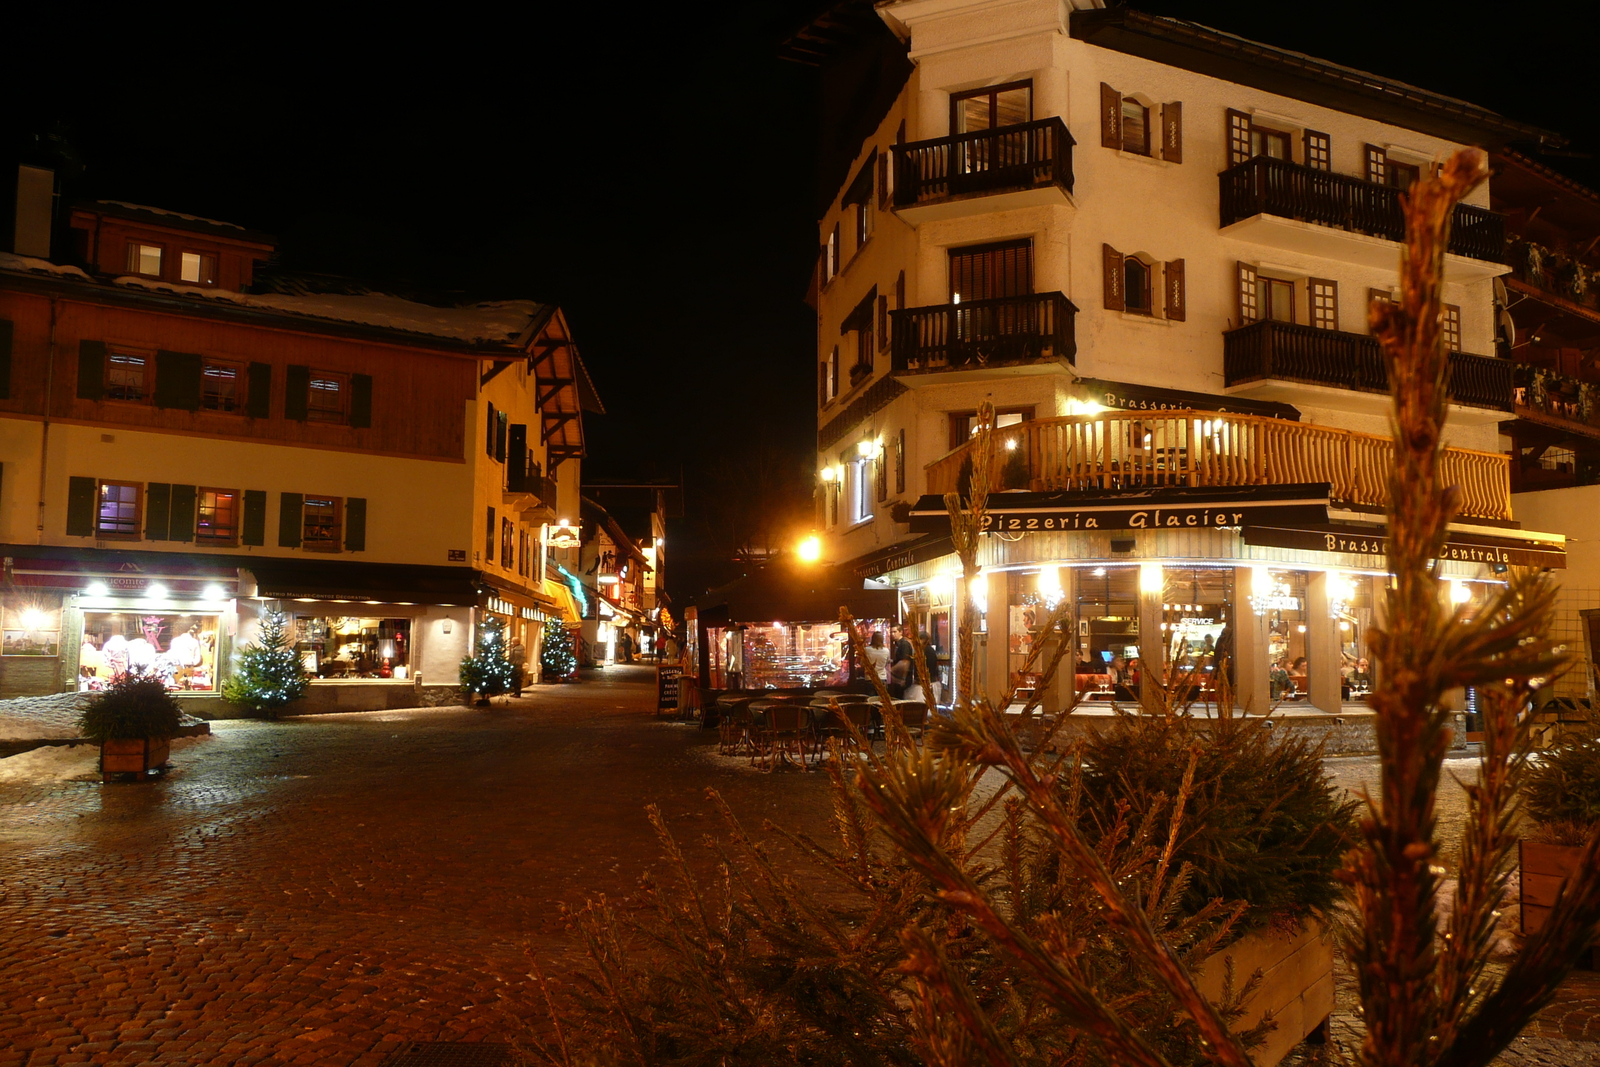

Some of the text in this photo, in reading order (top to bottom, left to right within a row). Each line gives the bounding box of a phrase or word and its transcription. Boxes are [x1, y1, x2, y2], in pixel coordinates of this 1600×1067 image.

[1104, 392, 1192, 411] Brasserie
[980, 509, 1242, 531] Pizzeria Glacier
[886, 550, 915, 572] Centrale
[1438, 544, 1510, 563] Centrale
[1180, 617, 1214, 625] SERVICE
